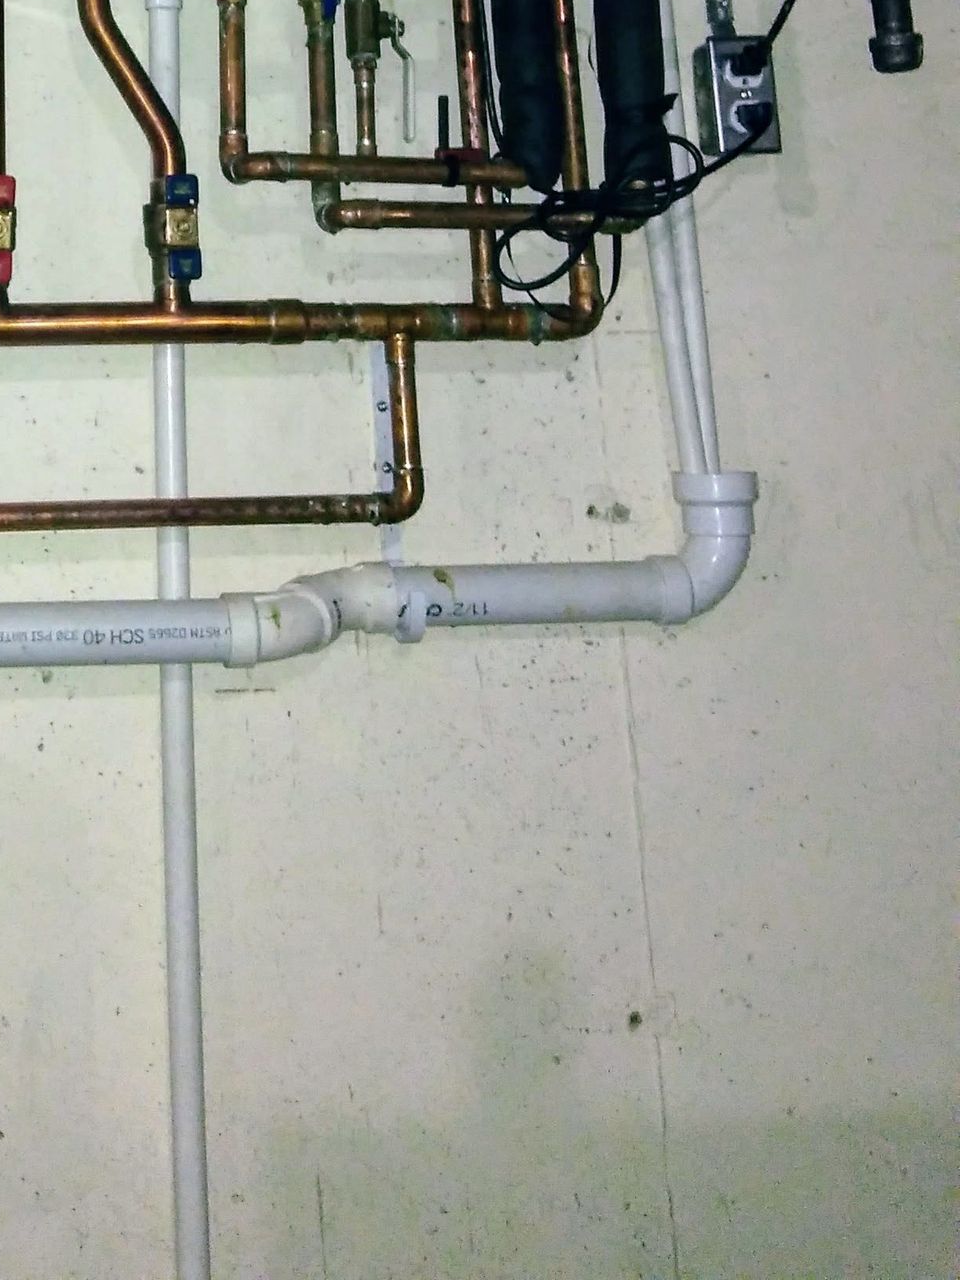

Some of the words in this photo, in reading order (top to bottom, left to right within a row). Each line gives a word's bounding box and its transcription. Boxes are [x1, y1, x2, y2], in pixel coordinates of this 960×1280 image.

[31, 630, 53, 642] PSI
[83, 629, 107, 645] 40
[110, 628, 145, 645] SCH
